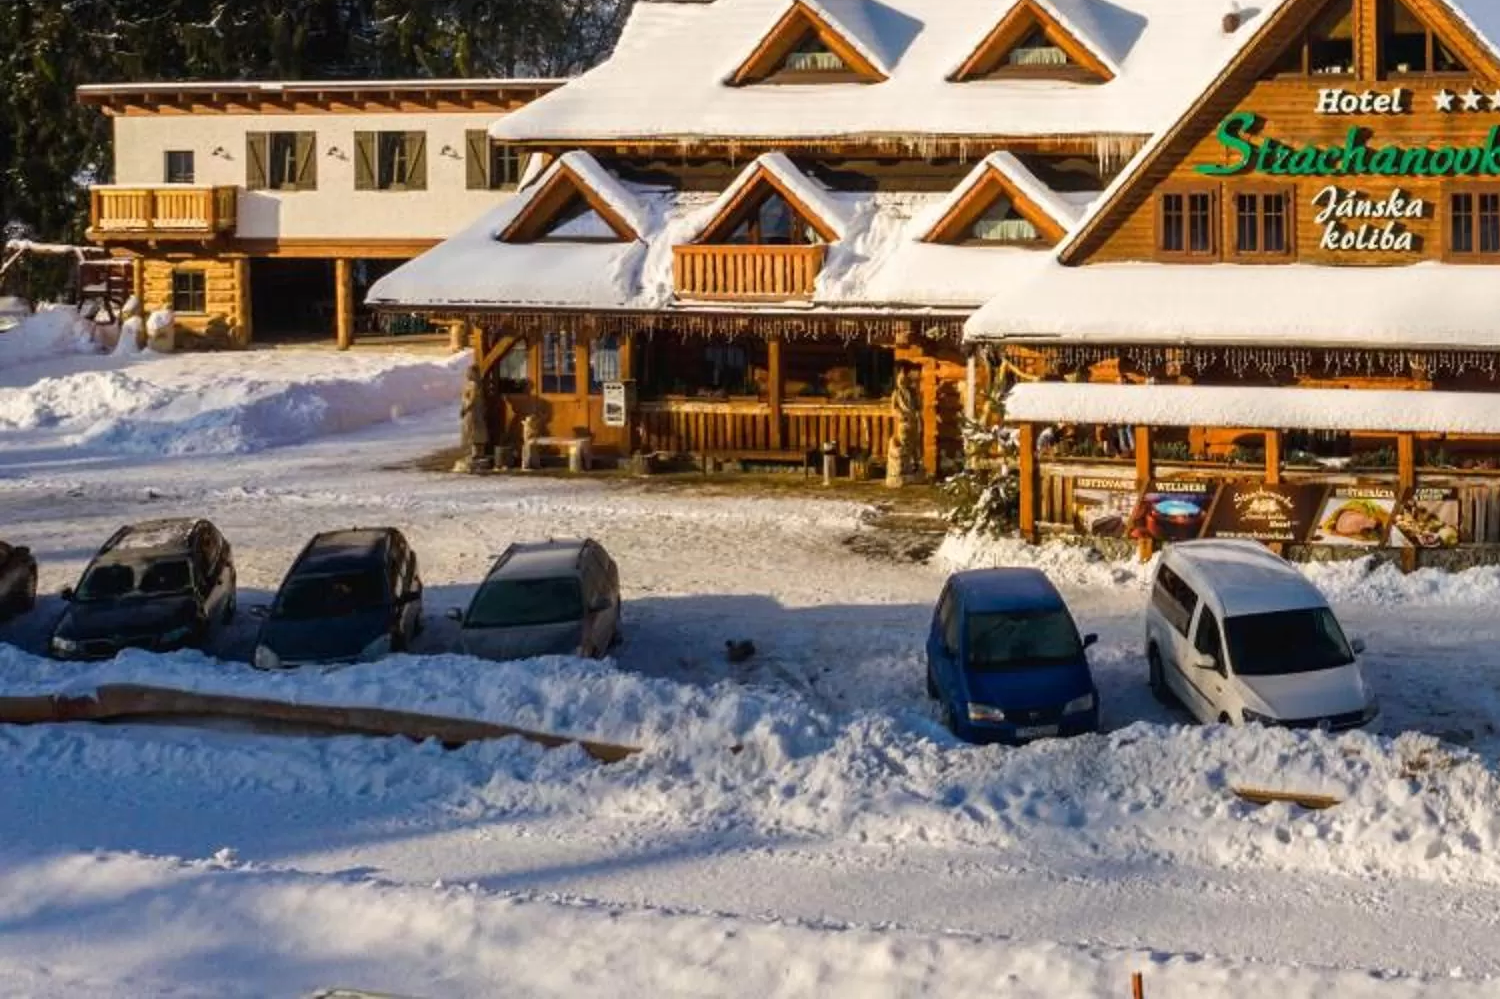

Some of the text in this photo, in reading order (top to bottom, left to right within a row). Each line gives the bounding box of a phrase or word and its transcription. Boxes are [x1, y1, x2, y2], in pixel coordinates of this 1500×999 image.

[1314, 88, 1403, 114] Hotel
[1311, 185, 1424, 225] Jánska
[1320, 220, 1413, 250] koliba
[1155, 482, 1207, 492] WELLNESS
